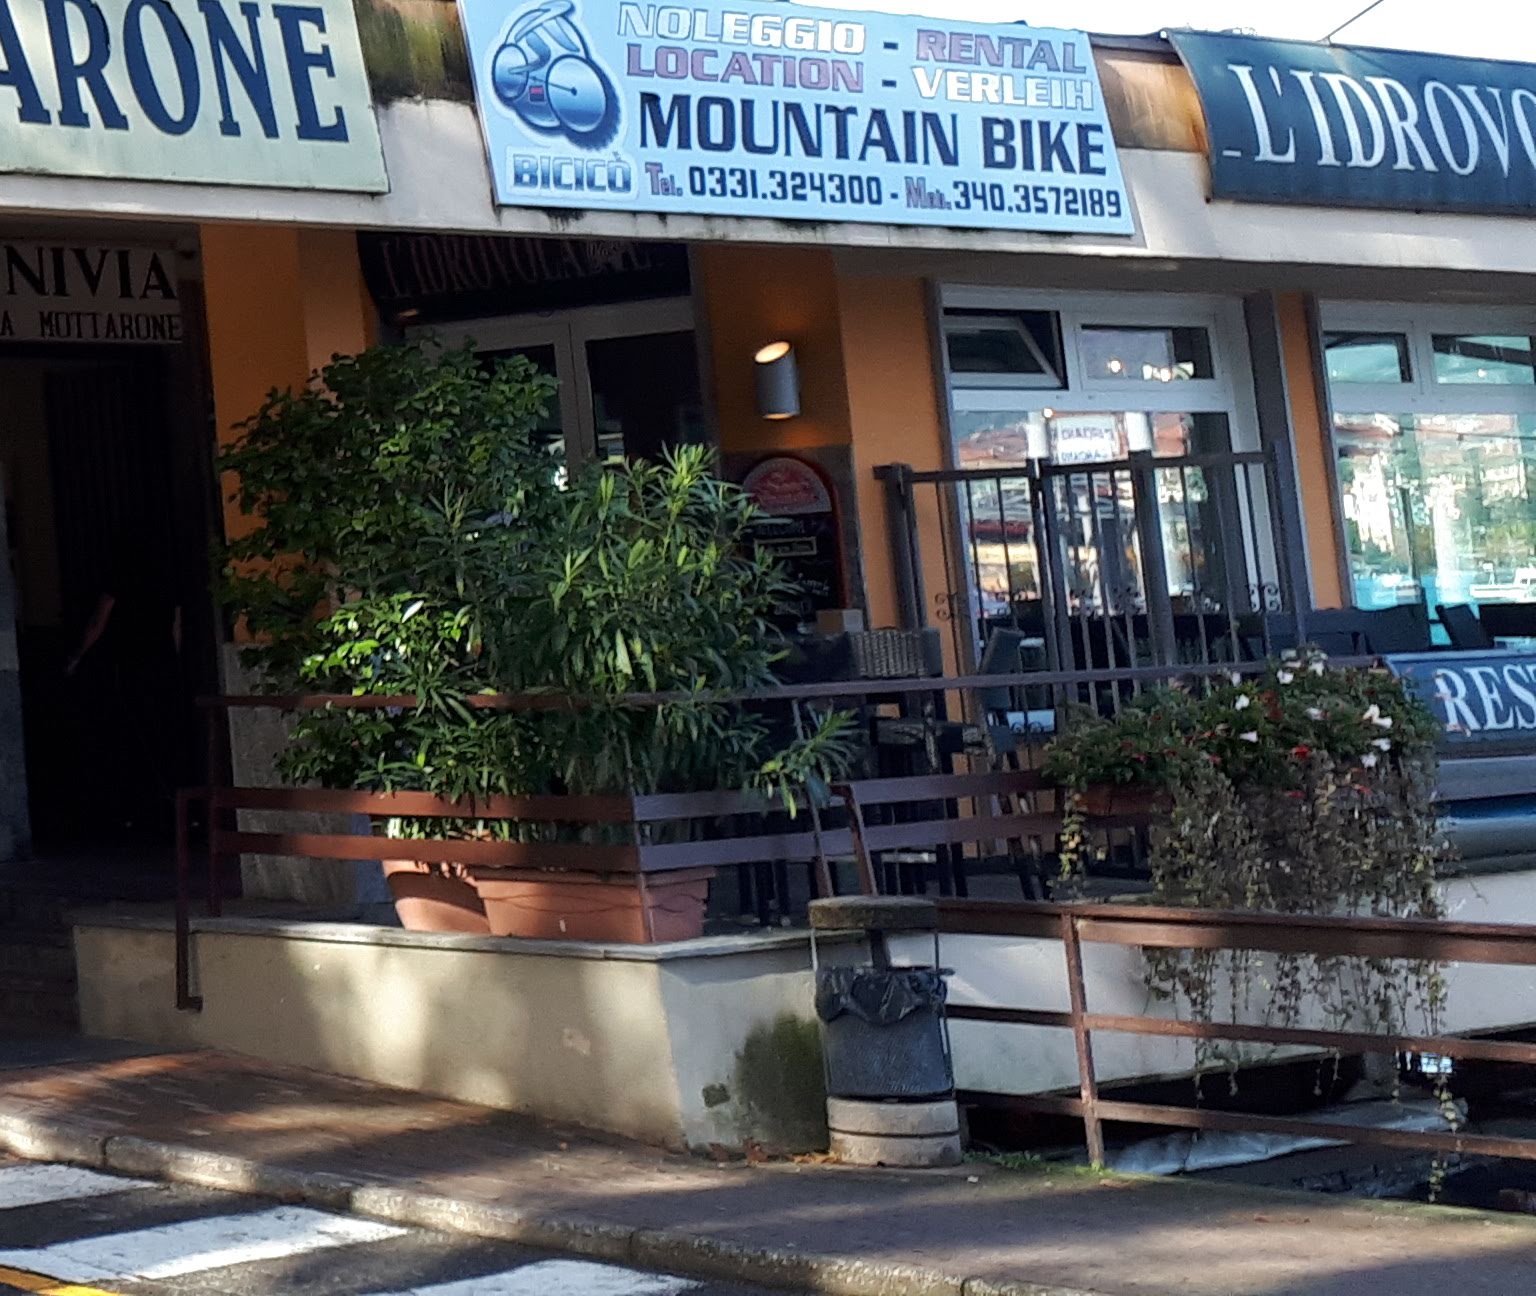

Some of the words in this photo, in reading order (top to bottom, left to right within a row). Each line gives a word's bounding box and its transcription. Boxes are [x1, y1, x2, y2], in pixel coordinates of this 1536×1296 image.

[617, 1, 866, 55] NOLEGGIO
[916, 28, 1087, 74] RENTAL
[626, 43, 864, 93] LOCATION
[912, 65, 1094, 110] VERLEIH
[639, 91, 959, 166] MOUNTAIN
[982, 115, 1107, 176] BIKE
[513, 151, 632, 194] BICICÒ
[645, 161, 684, 197] Tel.
[688, 165, 883, 206] 0331.324300
[953, 180, 1122, 218] 340.3572189
[39, 311, 182, 341] MOTTARONE
[1435, 663, 1536, 732] RES
